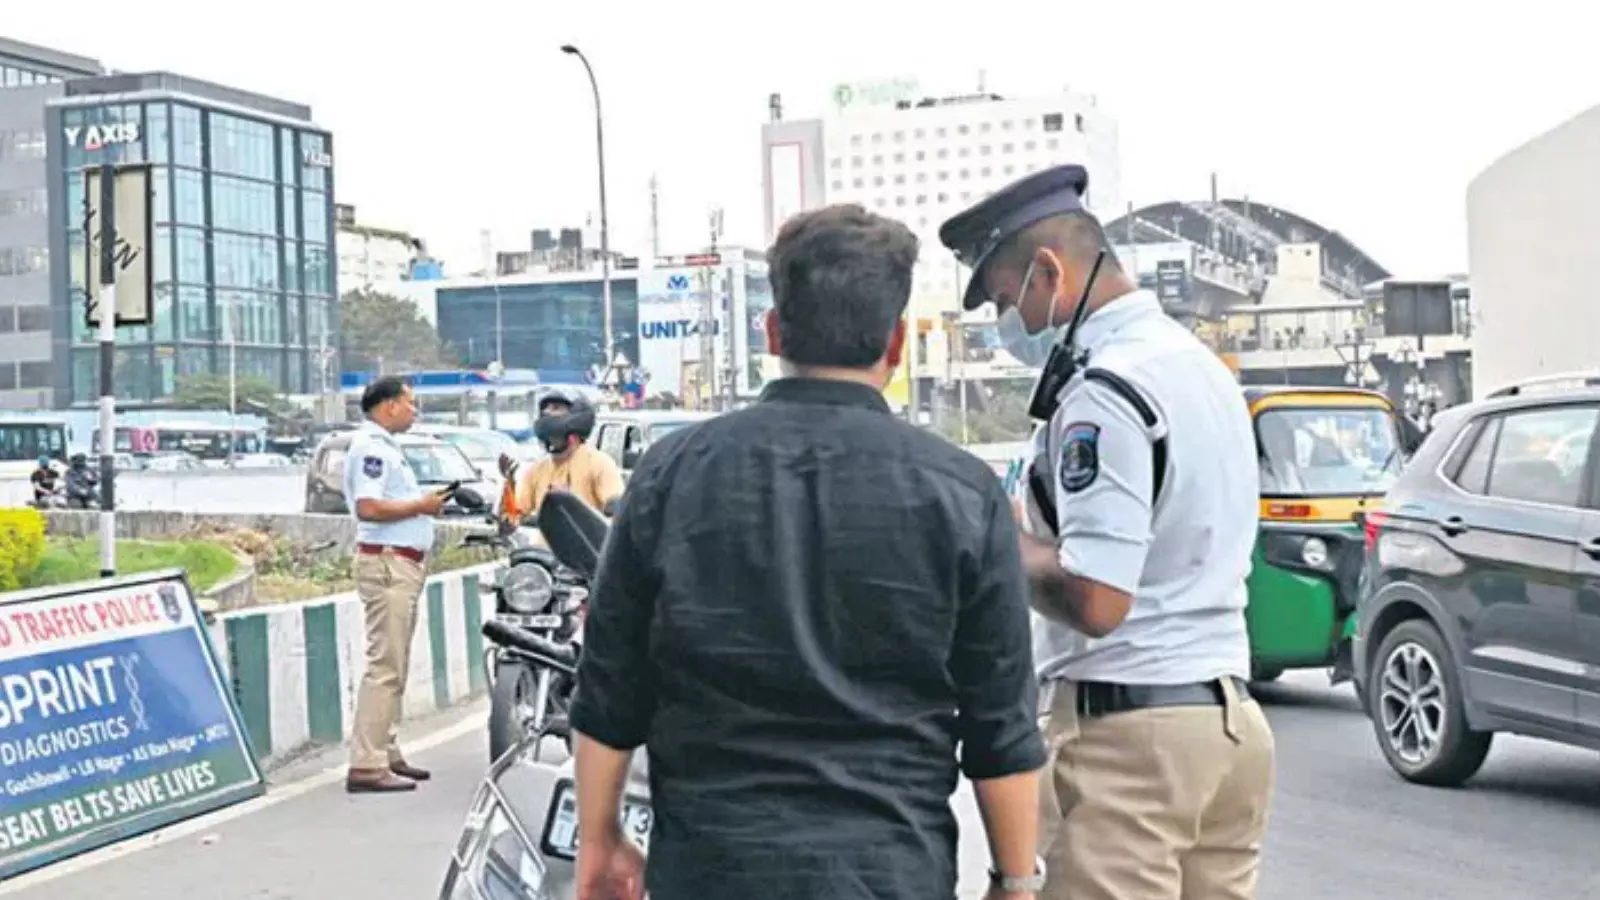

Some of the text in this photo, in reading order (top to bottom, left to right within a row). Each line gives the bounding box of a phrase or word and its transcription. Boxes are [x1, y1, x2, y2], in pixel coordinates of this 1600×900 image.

[64, 122, 139, 151] Y AXIS
[11, 603, 97, 646] TRAFFIC
[93, 592, 159, 631] POLICE
[0, 716, 129, 767] DIAGNOSTICS
[48, 789, 115, 834] BELTS
[112, 774, 166, 812] SAVE
[162, 760, 216, 798] LIVES
